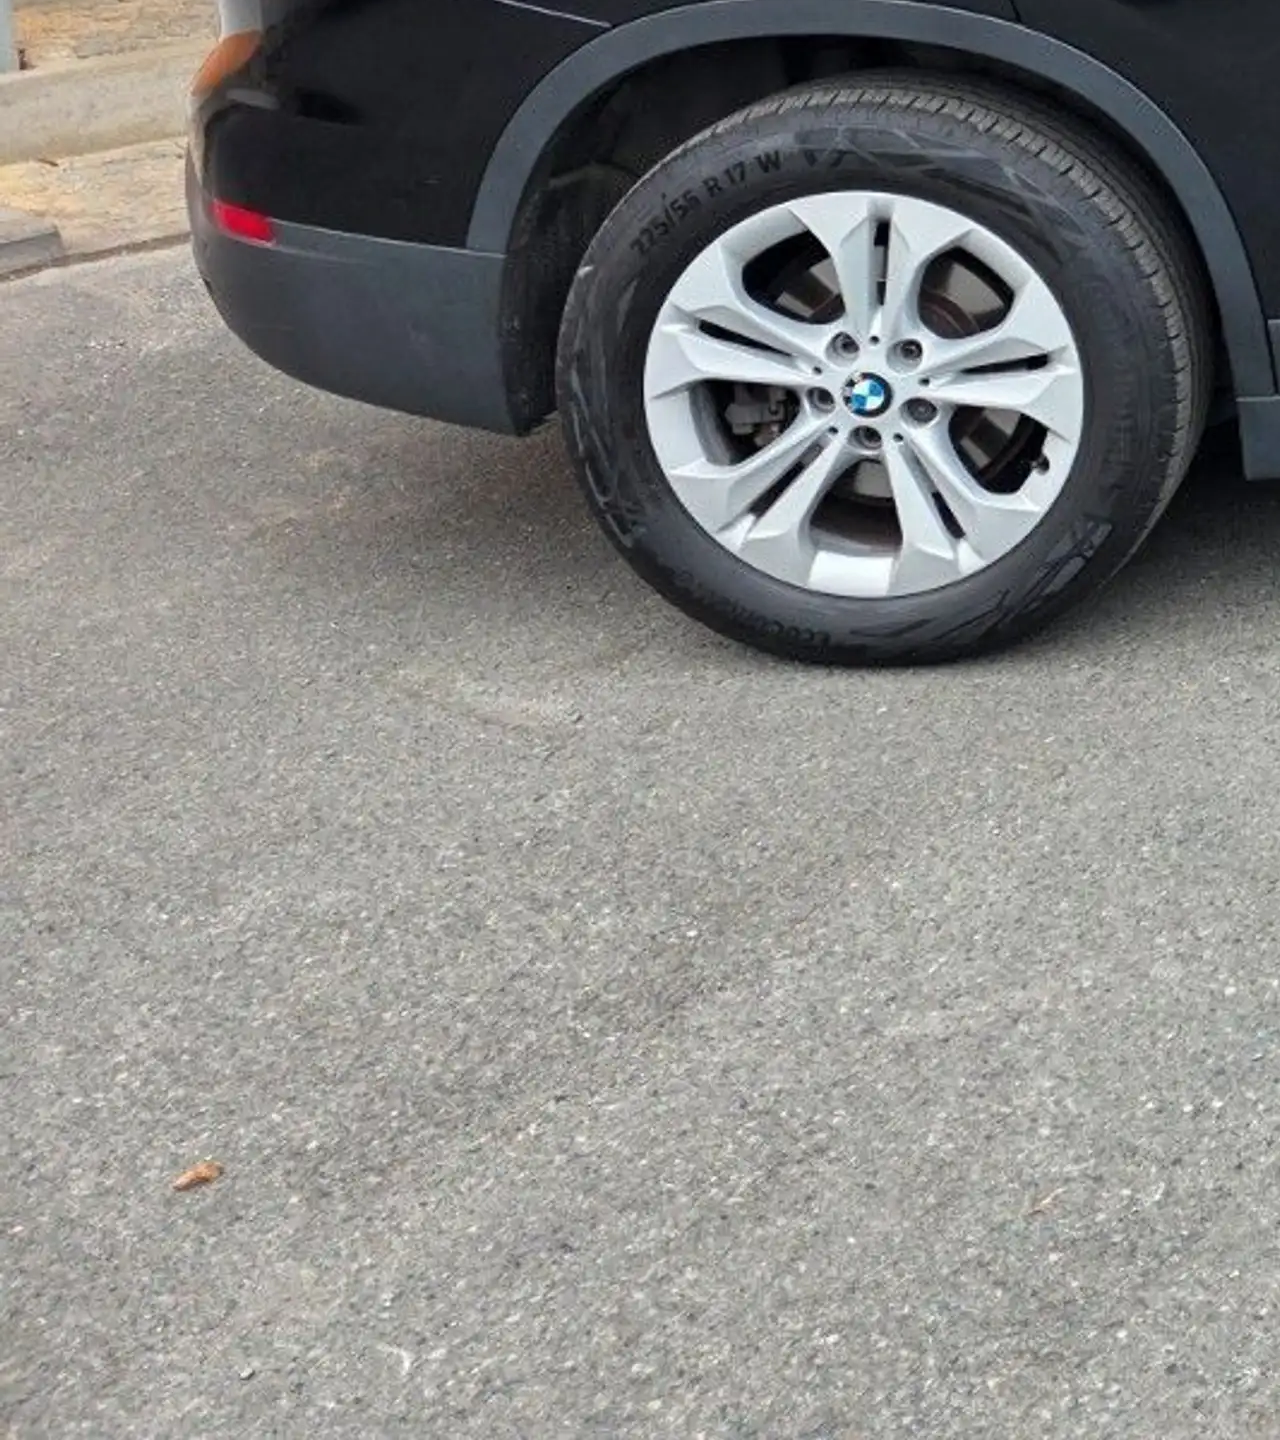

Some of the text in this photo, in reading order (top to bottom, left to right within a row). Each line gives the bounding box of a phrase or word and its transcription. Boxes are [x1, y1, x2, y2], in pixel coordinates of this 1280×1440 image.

[703, 175, 722, 198] R
[724, 160, 746, 184] 17
[755, 149, 783, 174] W
